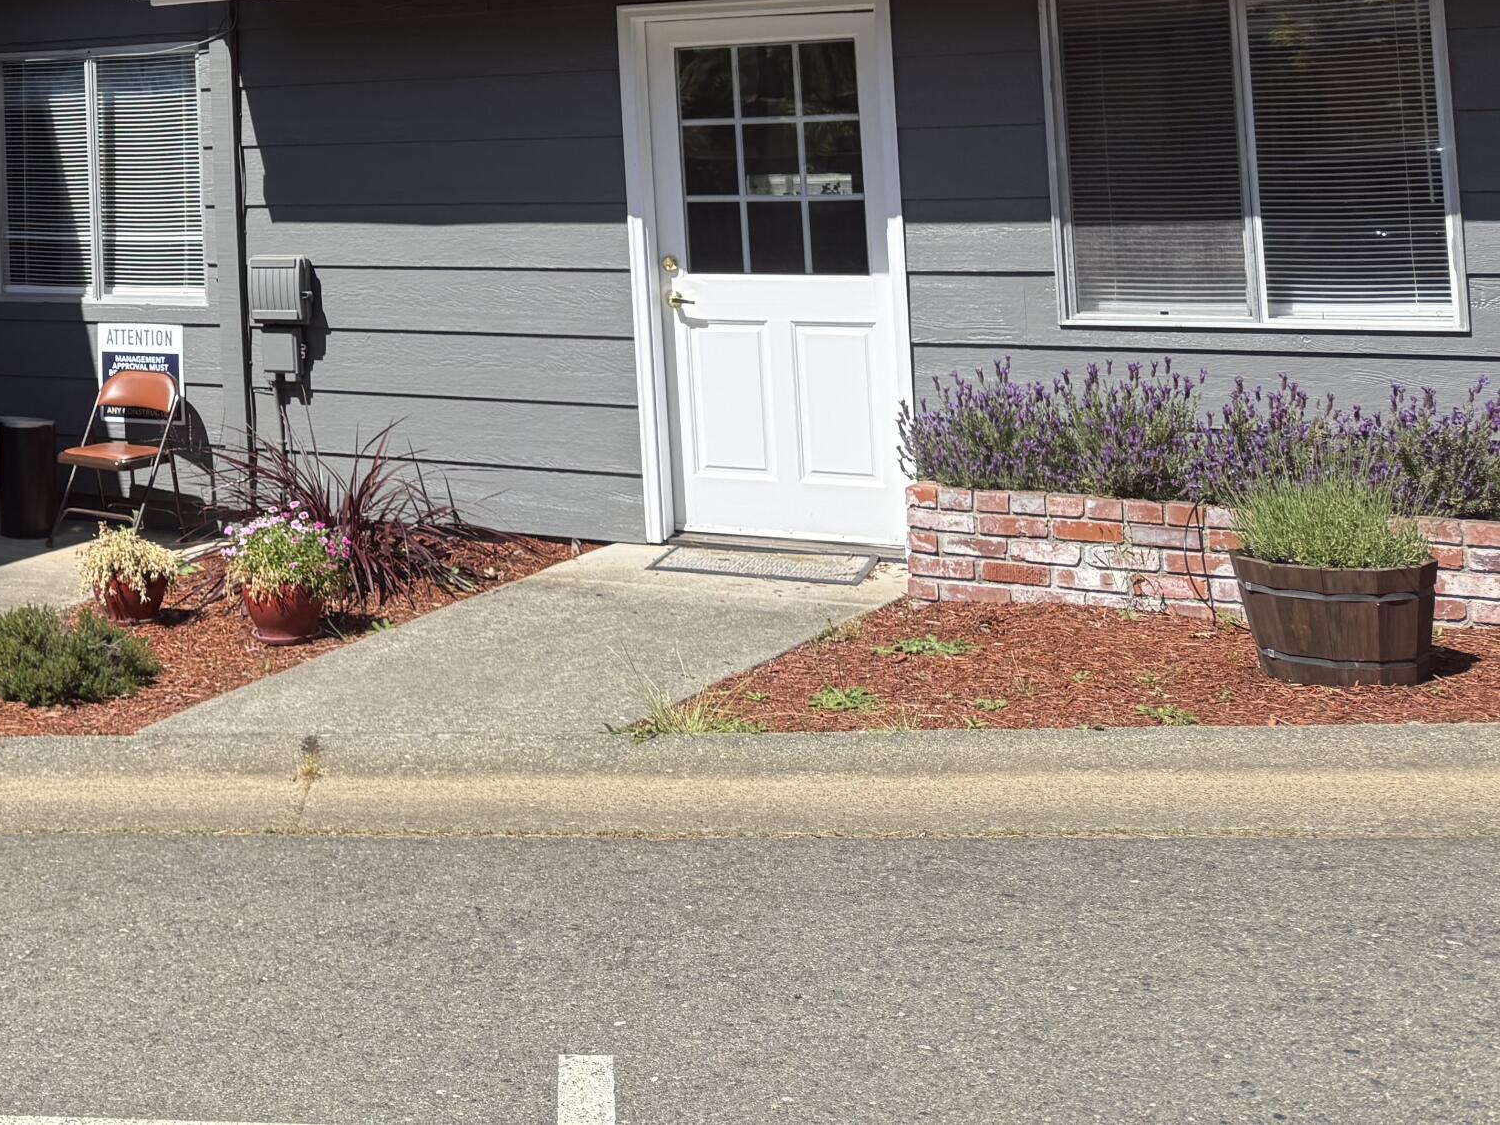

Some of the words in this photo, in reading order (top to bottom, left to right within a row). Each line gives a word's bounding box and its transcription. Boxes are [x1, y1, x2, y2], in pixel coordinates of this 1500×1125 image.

[106, 328, 173, 347] ATTENTION
[114, 355, 166, 364] MANAGEMENT
[111, 362, 149, 371] APPROVAL
[148, 363, 169, 372] MUST
[106, 407, 121, 415] ANY
